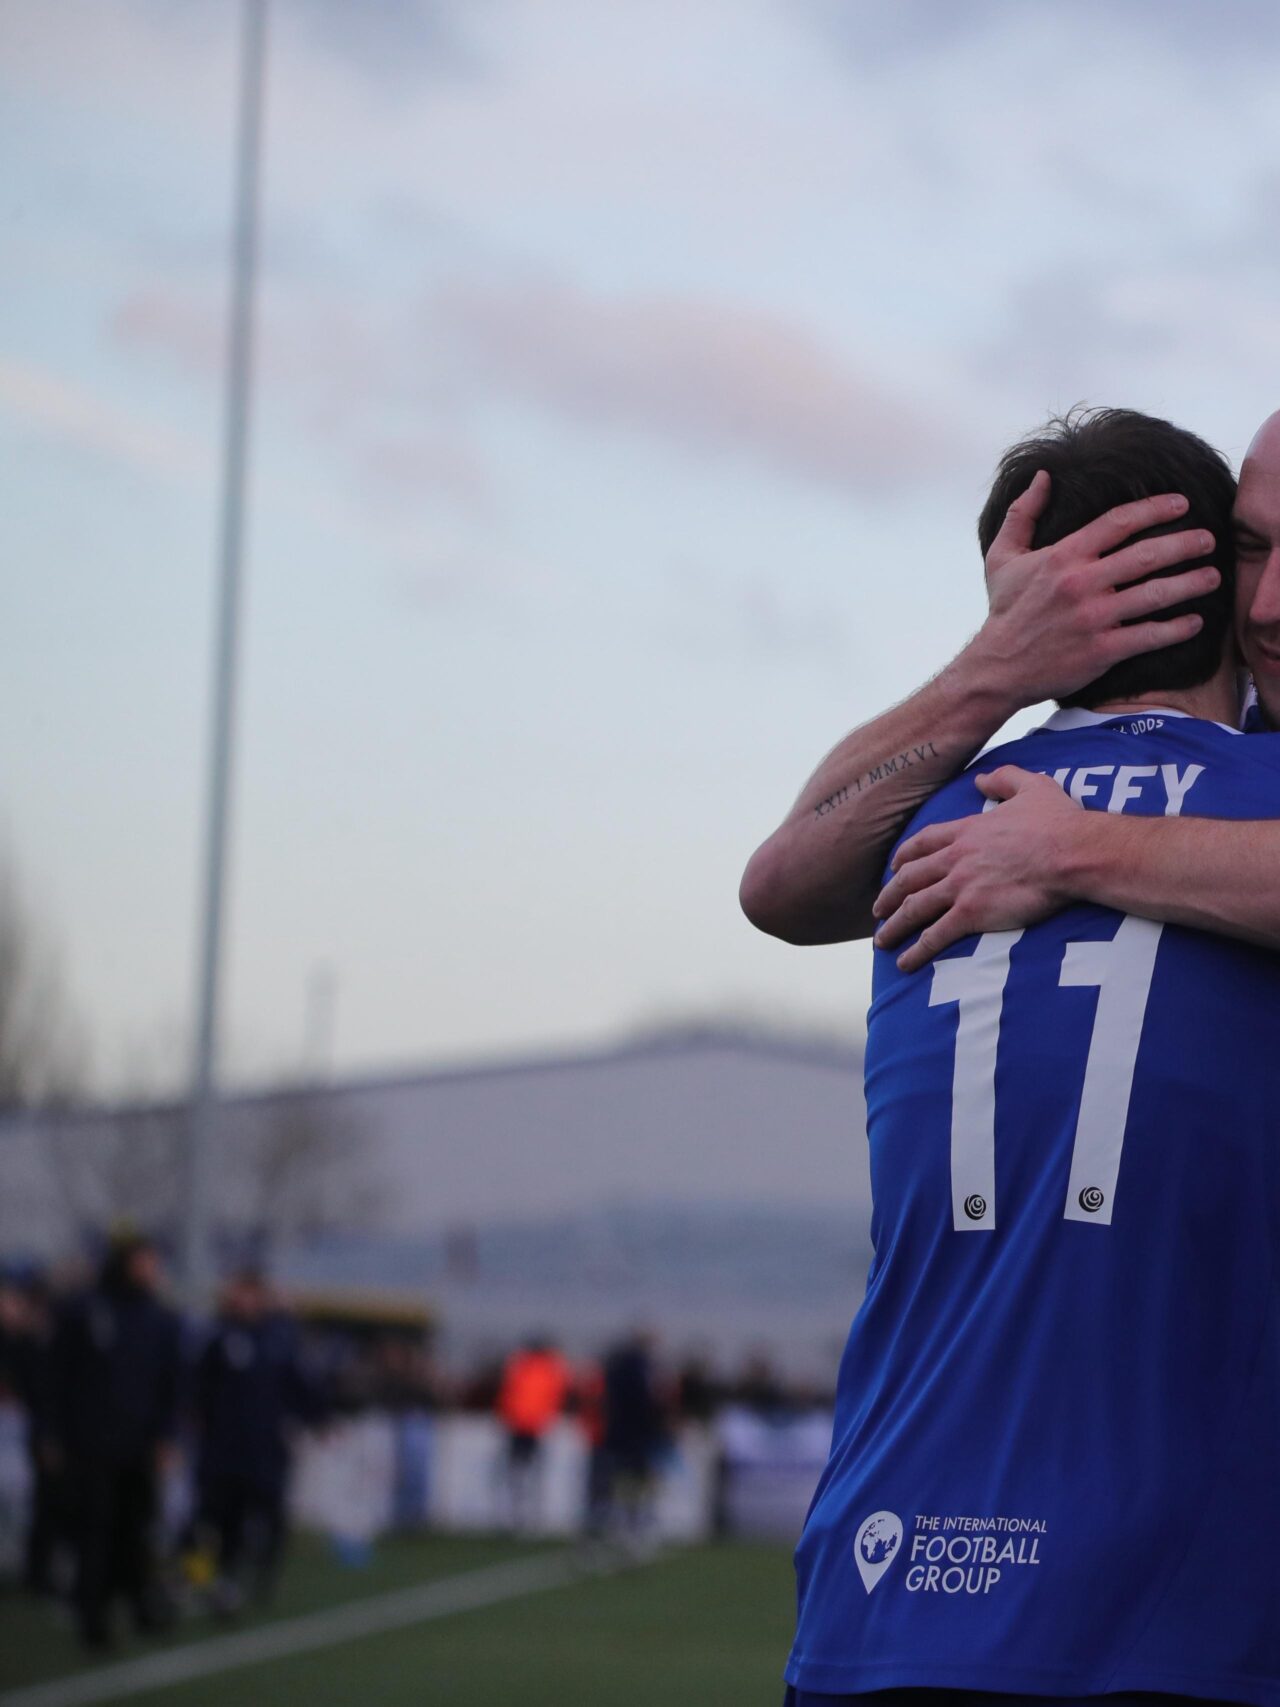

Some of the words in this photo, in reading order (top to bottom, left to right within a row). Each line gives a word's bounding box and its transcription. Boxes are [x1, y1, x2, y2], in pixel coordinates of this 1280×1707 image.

[928, 914, 1165, 1231] 11
[915, 1515, 940, 1530] THE
[943, 1517, 1047, 1533] INTERNATIONAL
[910, 1535, 1041, 1564] FOOTBALL
[905, 1565, 1001, 1594] GROUP
